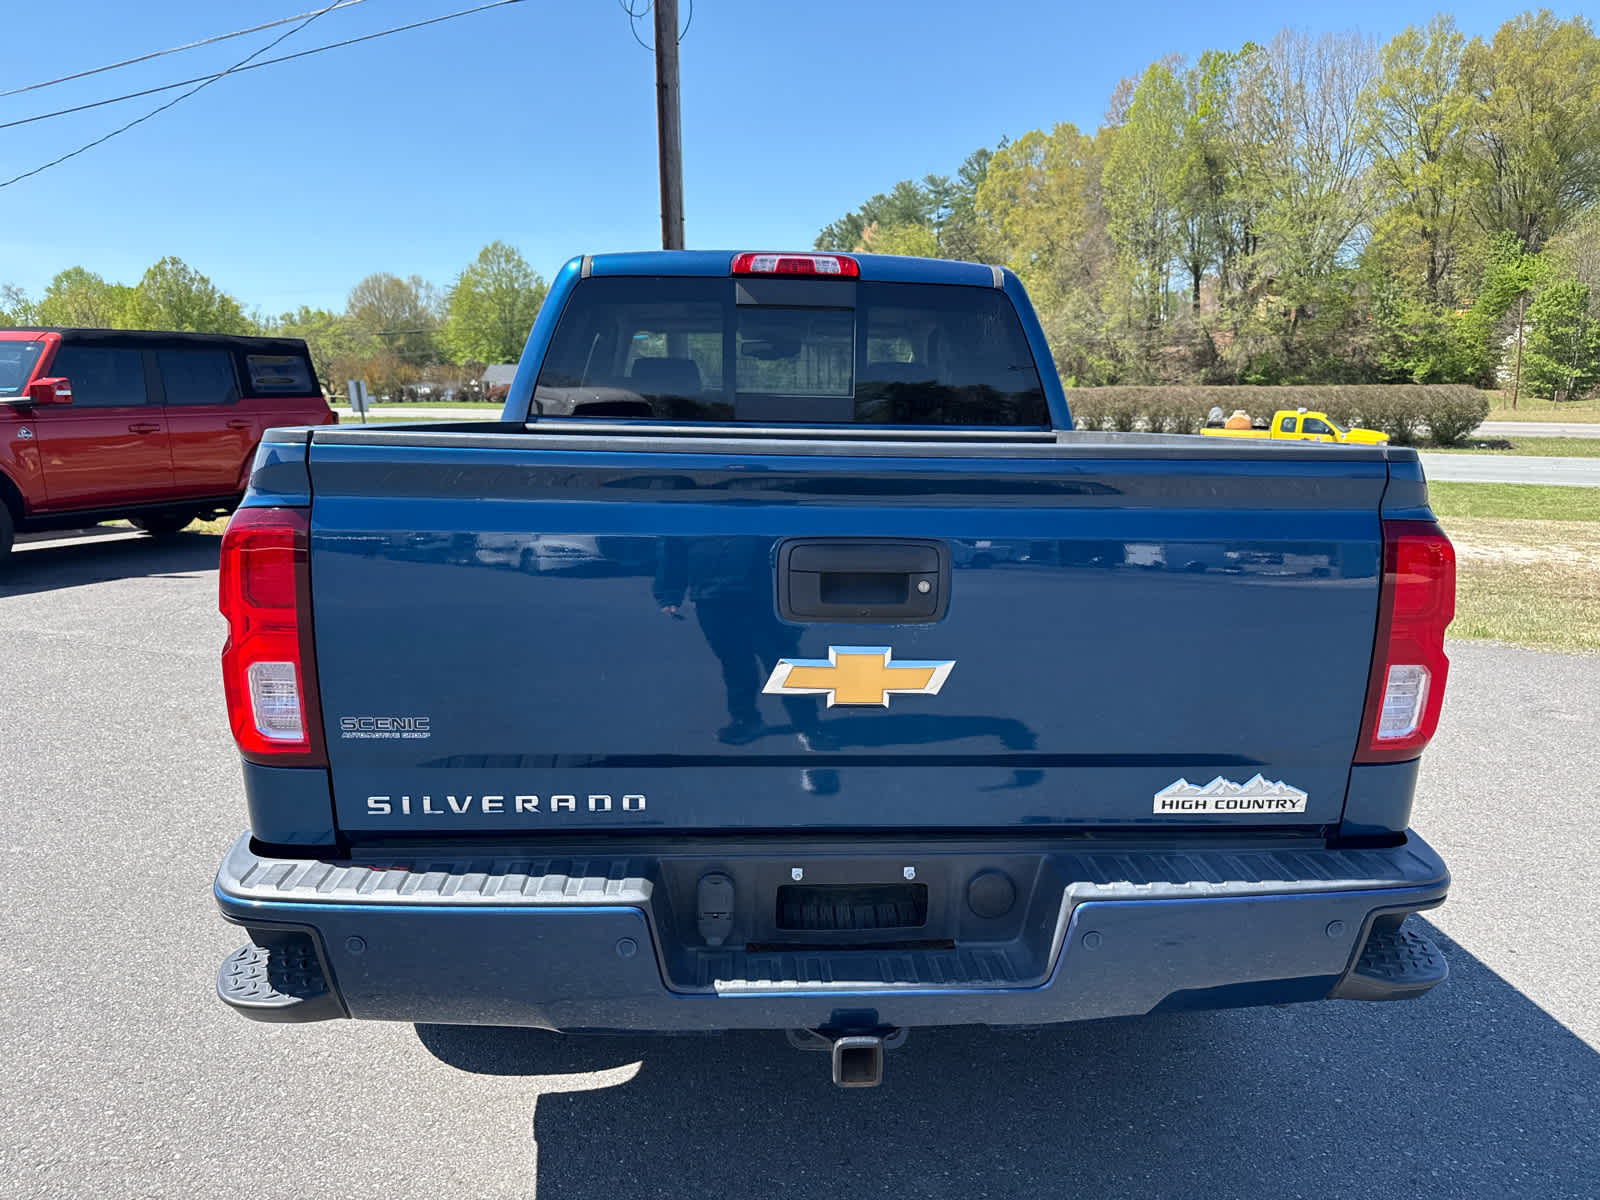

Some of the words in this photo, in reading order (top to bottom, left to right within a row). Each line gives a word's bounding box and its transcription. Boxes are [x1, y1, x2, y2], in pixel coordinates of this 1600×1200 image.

[341, 716, 430, 730] SCENIC
[367, 794, 647, 815] SILVERADO
[1161, 799, 1207, 810] HIGH
[1214, 799, 1301, 810] COUNTRY
